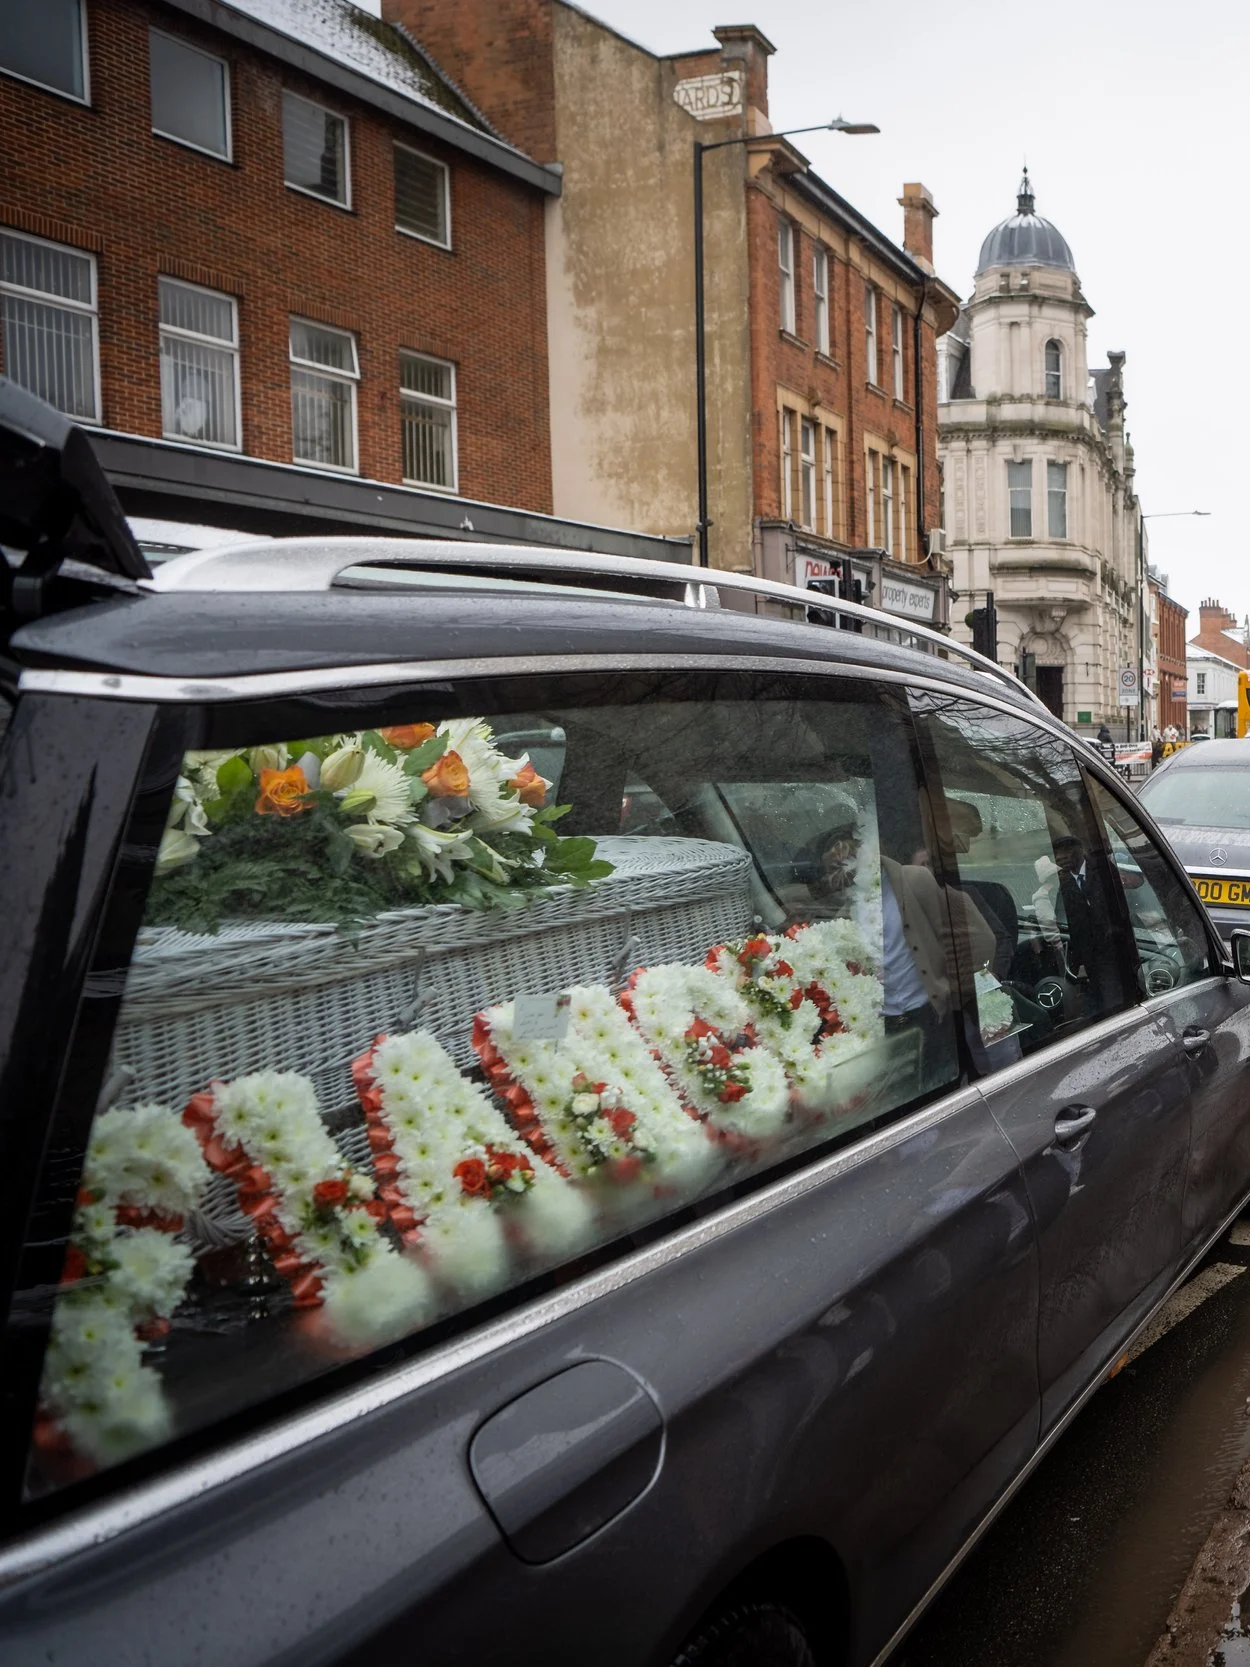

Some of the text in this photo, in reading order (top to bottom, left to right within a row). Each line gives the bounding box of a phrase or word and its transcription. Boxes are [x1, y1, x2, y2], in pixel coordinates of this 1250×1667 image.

[883, 586, 930, 610] property experts
[1123, 675, 1134, 683] 20
